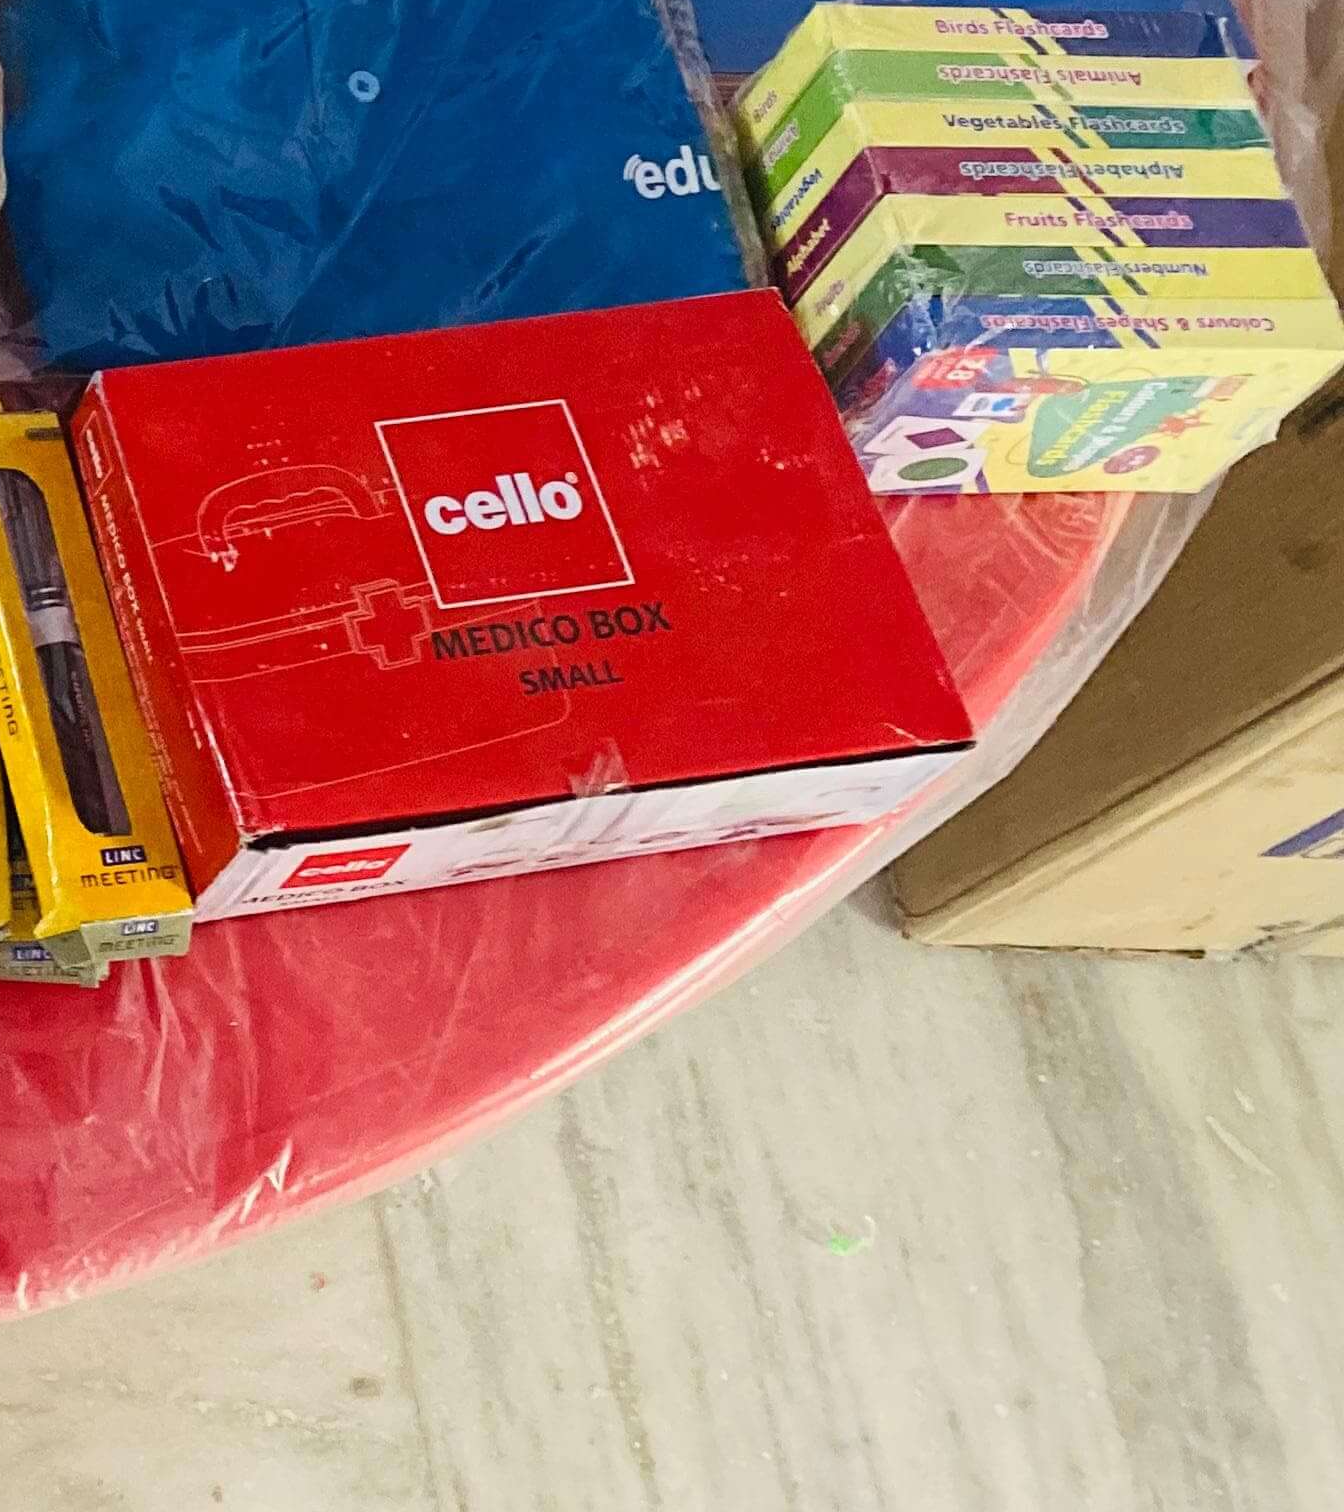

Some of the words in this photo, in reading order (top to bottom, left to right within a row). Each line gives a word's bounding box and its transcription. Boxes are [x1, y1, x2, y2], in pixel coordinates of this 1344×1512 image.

[934, 19, 990, 37] Birds
[994, 18, 1109, 39] Flashcards
[938, 65, 1053, 85] Flashcards
[1057, 66, 1143, 85] Animals
[942, 114, 1062, 135] Vegetables
[1067, 114, 1186, 135] Flashcards
[959, 161, 1078, 180] Flashcards
[1086, 162, 1185, 179] Alphabet
[1003, 212, 1069, 230] Fruits
[1073, 210, 1194, 231] Flashcards
[1022, 259, 1121, 277] Flashcards
[1122, 261, 1209, 277] Numbers
[1096, 314, 1170, 331] Shapes
[1174, 314, 1189, 330] &
[1196, 314, 1275, 332] Colours
[423, 472, 582, 536] cello
[430, 614, 581, 664] MEDICO
[588, 600, 672, 641] BOX
[518, 659, 626, 697] SMALL
[104, 849, 143, 865] LINC
[80, 864, 177, 888] MEETING
[297, 858, 392, 878] cello
[123, 921, 156, 934] LINC
